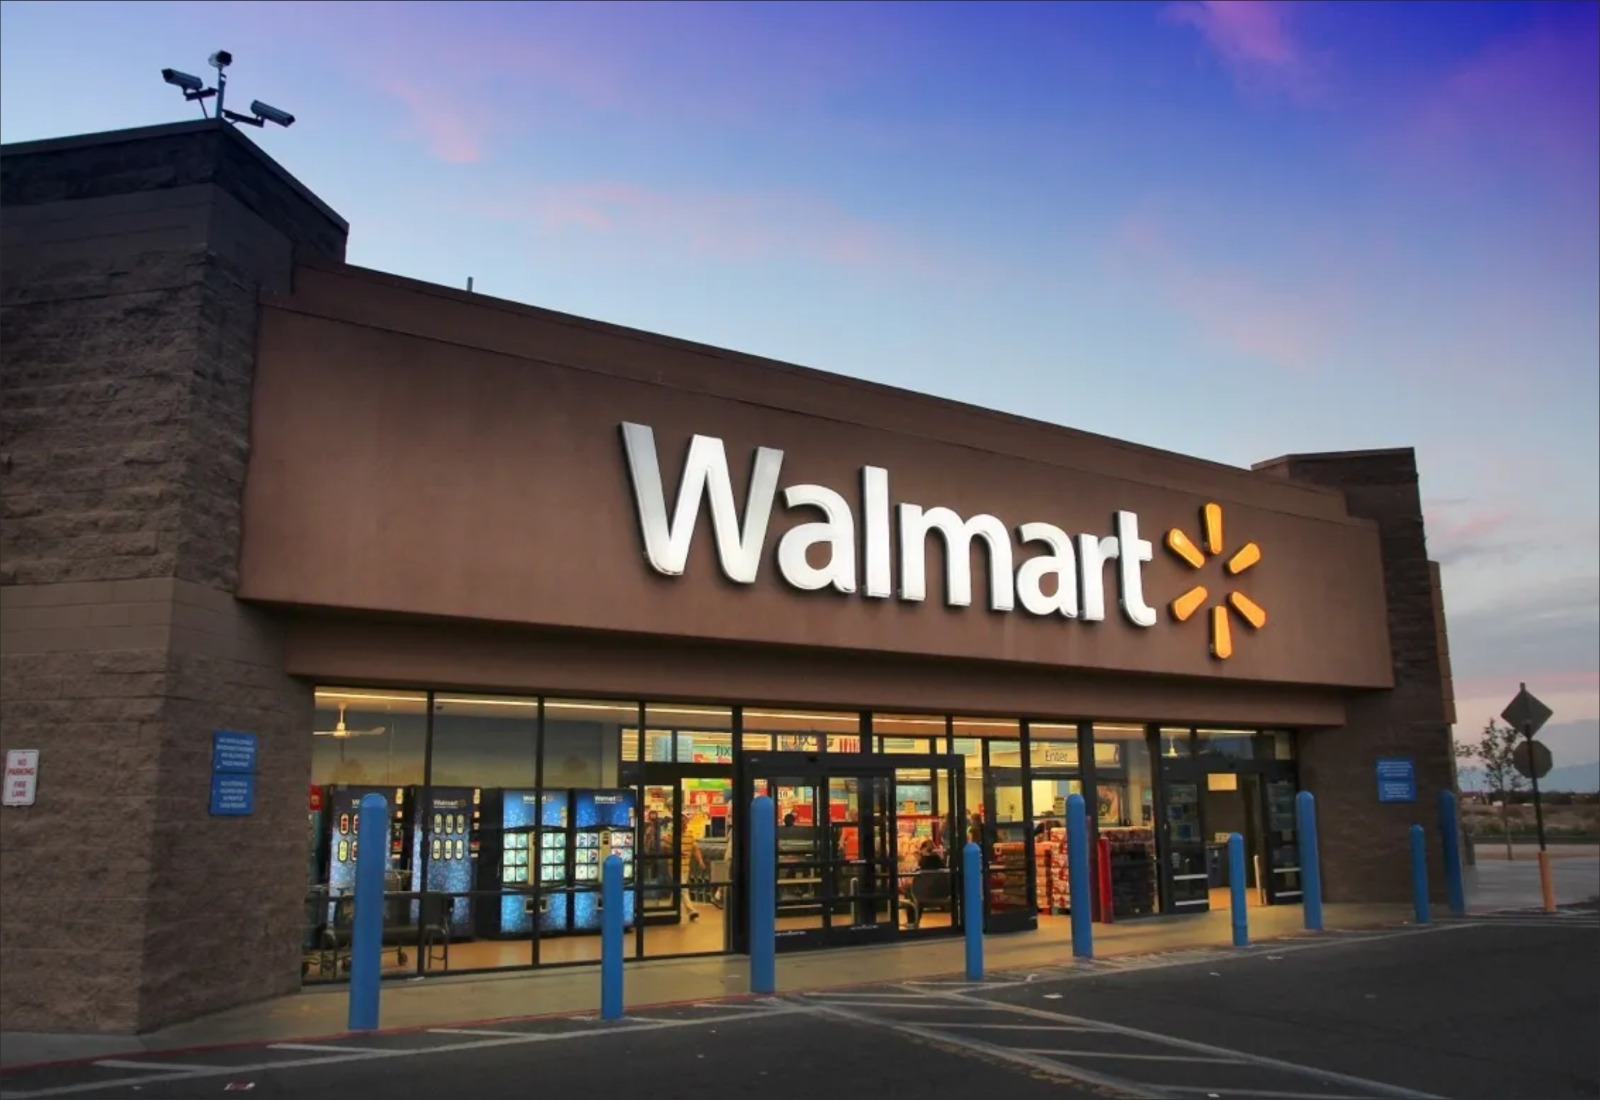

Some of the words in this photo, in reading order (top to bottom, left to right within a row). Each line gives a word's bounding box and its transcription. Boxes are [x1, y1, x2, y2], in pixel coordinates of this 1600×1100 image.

[619, 421, 1157, 628] Walmart
[1045, 749, 1068, 762] Enter
[17, 758, 27, 766] NO
[8, 768, 35, 776] PARKING
[13, 780, 27, 788] FIRE
[11, 790, 27, 798] LANE
